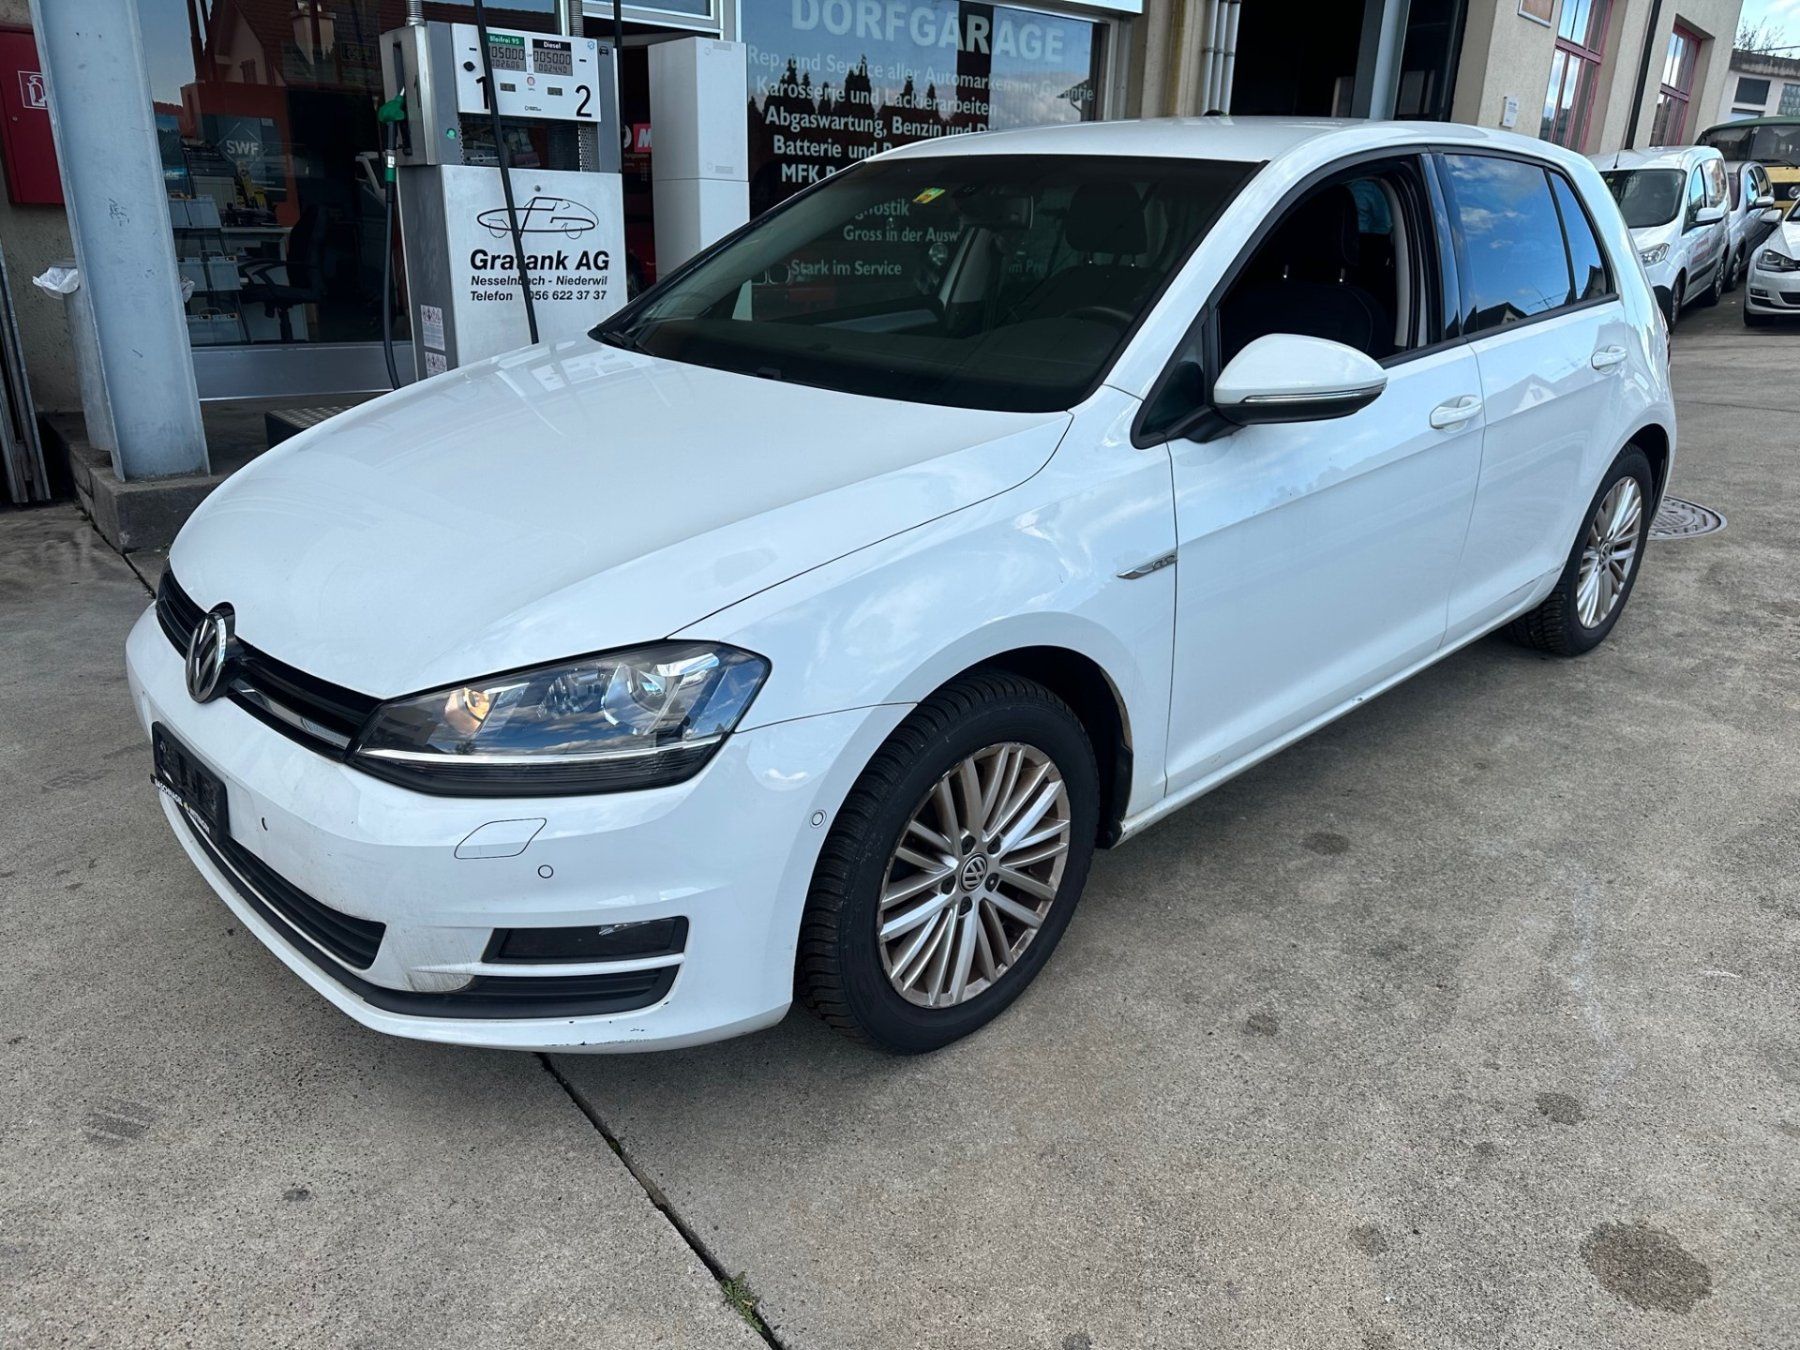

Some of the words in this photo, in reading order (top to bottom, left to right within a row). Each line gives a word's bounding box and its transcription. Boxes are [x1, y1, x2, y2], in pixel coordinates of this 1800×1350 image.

[791, 0, 1065, 63] DORFGARAGE
[543, 41, 562, 49] Diesel
[748, 43, 785, 72] Rep.
[790, 52, 821, 71] und
[826, 53, 884, 78] Service
[887, 61, 921, 82] aller
[924, 65, 1011, 92] Automarken
[476, 76, 489, 110] 1
[575, 84, 593, 118] 2
[756, 75, 846, 103] Karosserie
[850, 87, 879, 106] und
[884, 87, 997, 116] Lackierarbeiten
[765, 104, 888, 139] Abgaswartung,
[891, 115, 942, 138] Benzin
[945, 121, 972, 137] und
[226, 140, 260, 155] SWF
[773, 134, 842, 158] Batterie
[848, 141, 878, 160] und
[781, 162, 820, 184] MFK
[842, 224, 883, 242] Gross
[886, 225, 898, 242] in
[901, 226, 923, 242] der
[575, 249, 610, 271] AG
[790, 258, 829, 275] Stark
[833, 260, 851, 275] im
[854, 259, 902, 275] Service
[556, 274, 608, 286] Niederwil
[470, 290, 513, 301] Telefon
[528, 290, 549, 301] 056
[552, 290, 573, 301] 622
[576, 290, 590, 301] 37
[593, 290, 607, 301] 37
